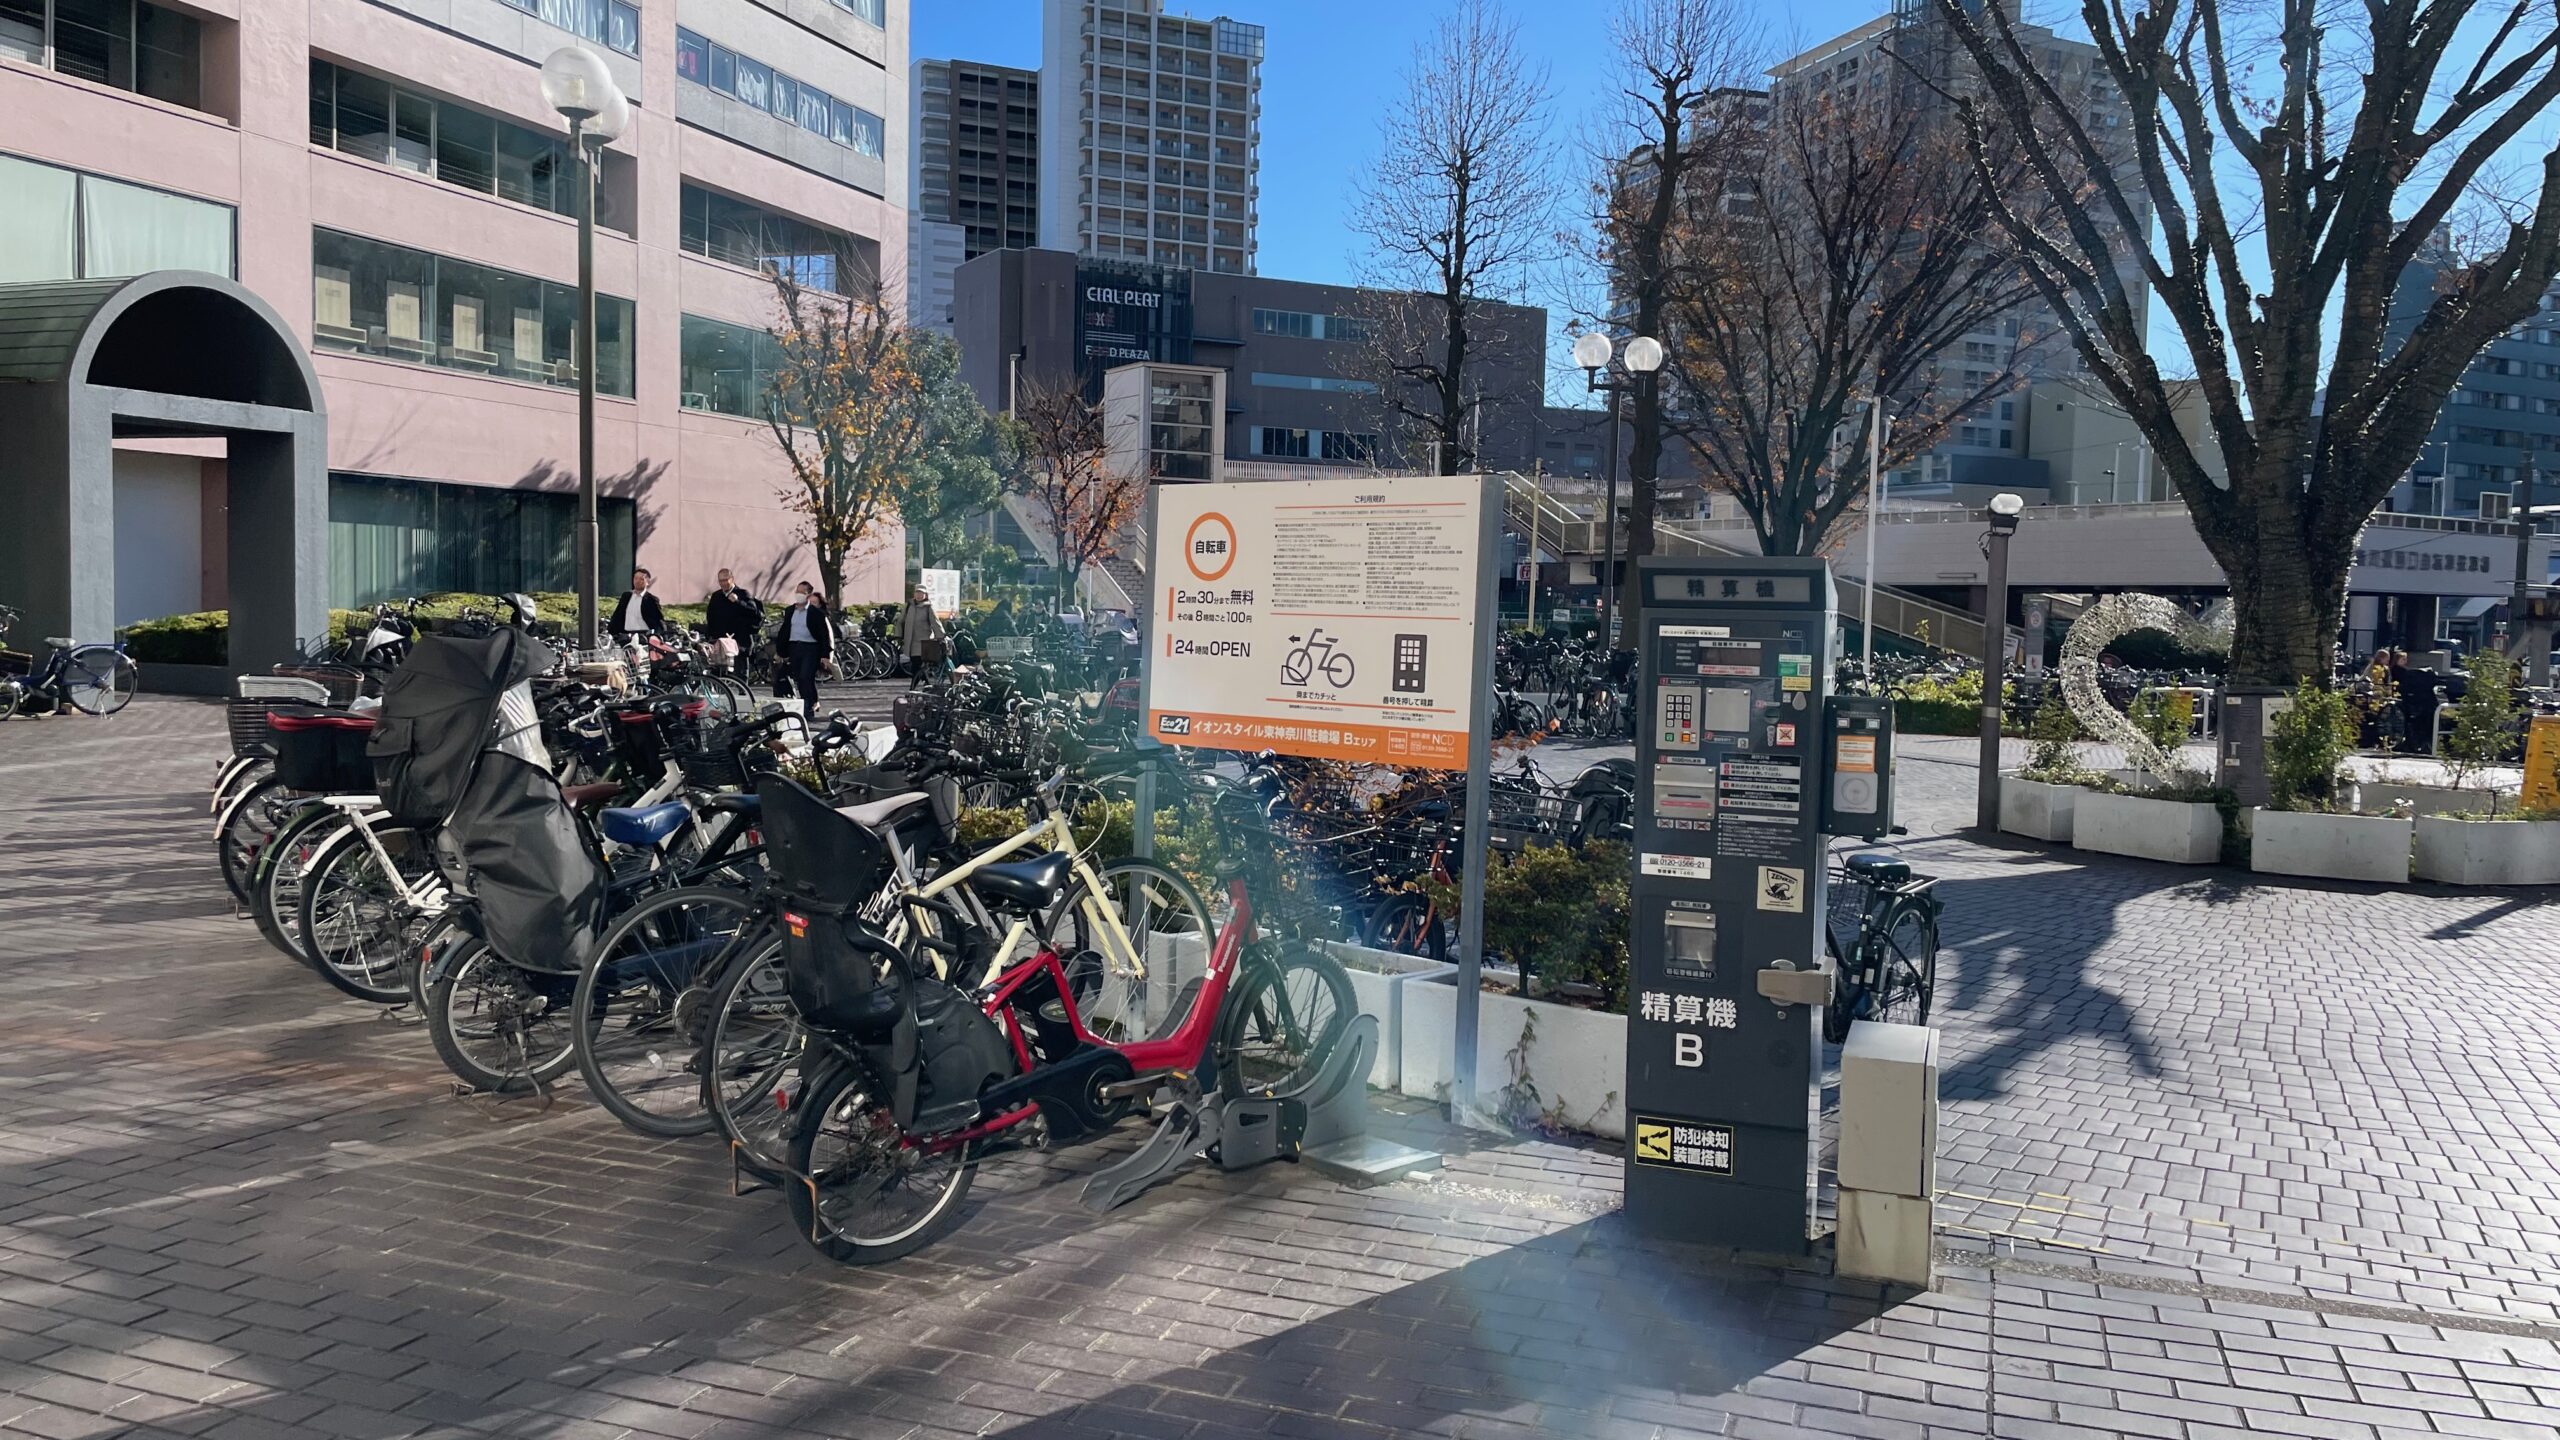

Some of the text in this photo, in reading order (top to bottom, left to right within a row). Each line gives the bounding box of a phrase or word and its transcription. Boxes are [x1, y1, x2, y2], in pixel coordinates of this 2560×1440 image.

[1087, 287, 1161, 308] CIAL PLAT
[1119, 348, 1150, 360] PLAZA
[1354, 495, 1386, 504] ご利用規約
[1195, 540, 1227, 554] 自転車
[1687, 579, 1776, 598] 精算機
[1382, 696, 1434, 707] 番号を押して精算
[1193, 720, 1341, 746] イオンスタイル東神奈川駐輪場
[1343, 732, 1377, 749] Bエリア
[1431, 733, 1455, 746] NCD
[1640, 990, 1738, 1030] 精算機
[1675, 1032, 1704, 1068] B
[1673, 1126, 1730, 1150] 防犯検知
[1673, 1145, 1730, 1169] 装置搭載
